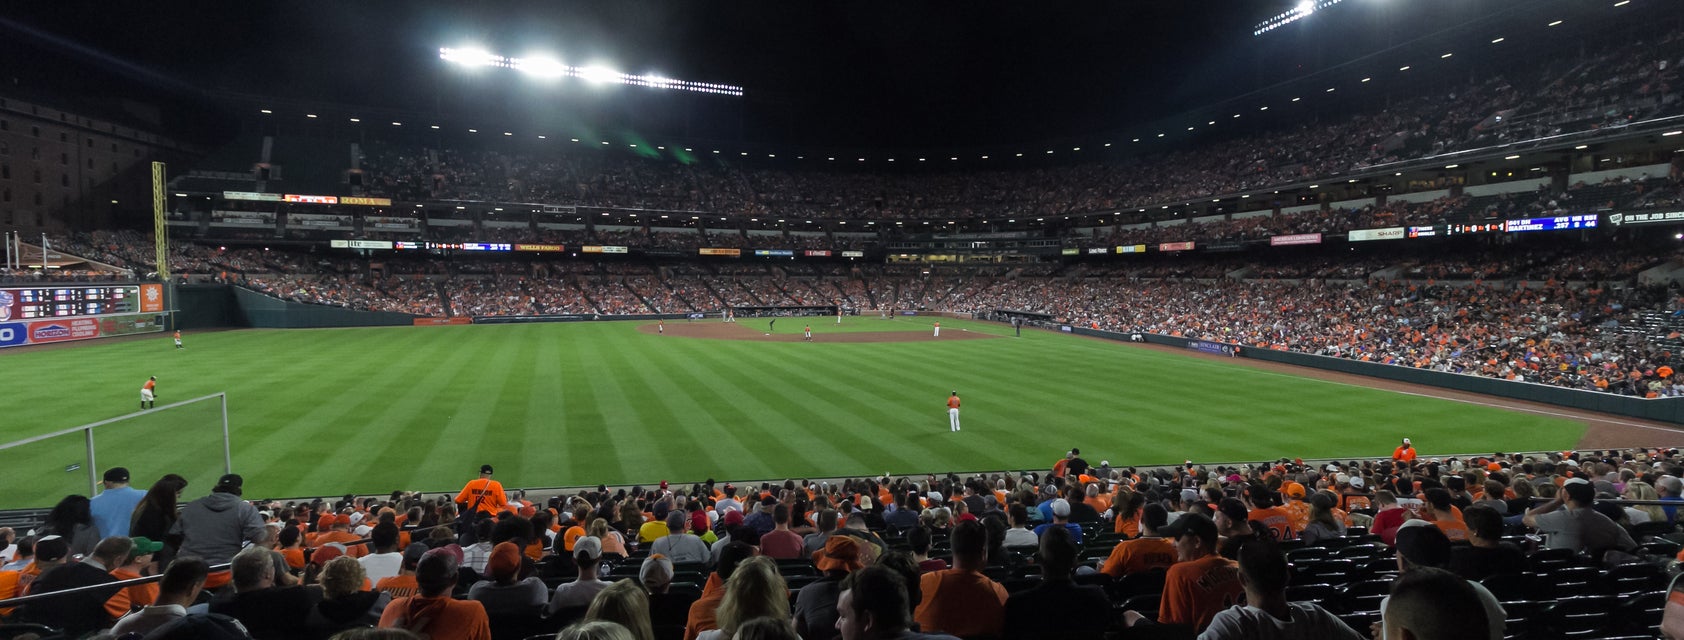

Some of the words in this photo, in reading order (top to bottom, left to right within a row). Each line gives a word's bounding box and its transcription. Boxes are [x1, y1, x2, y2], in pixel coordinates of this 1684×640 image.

[341, 197, 375, 205] ROMA
[1635, 213, 1649, 221] THE
[1650, 212, 1664, 220] JOB
[1508, 223, 1543, 231] MARTINEZ
[1200, 342, 1220, 350] SINCLAIR
